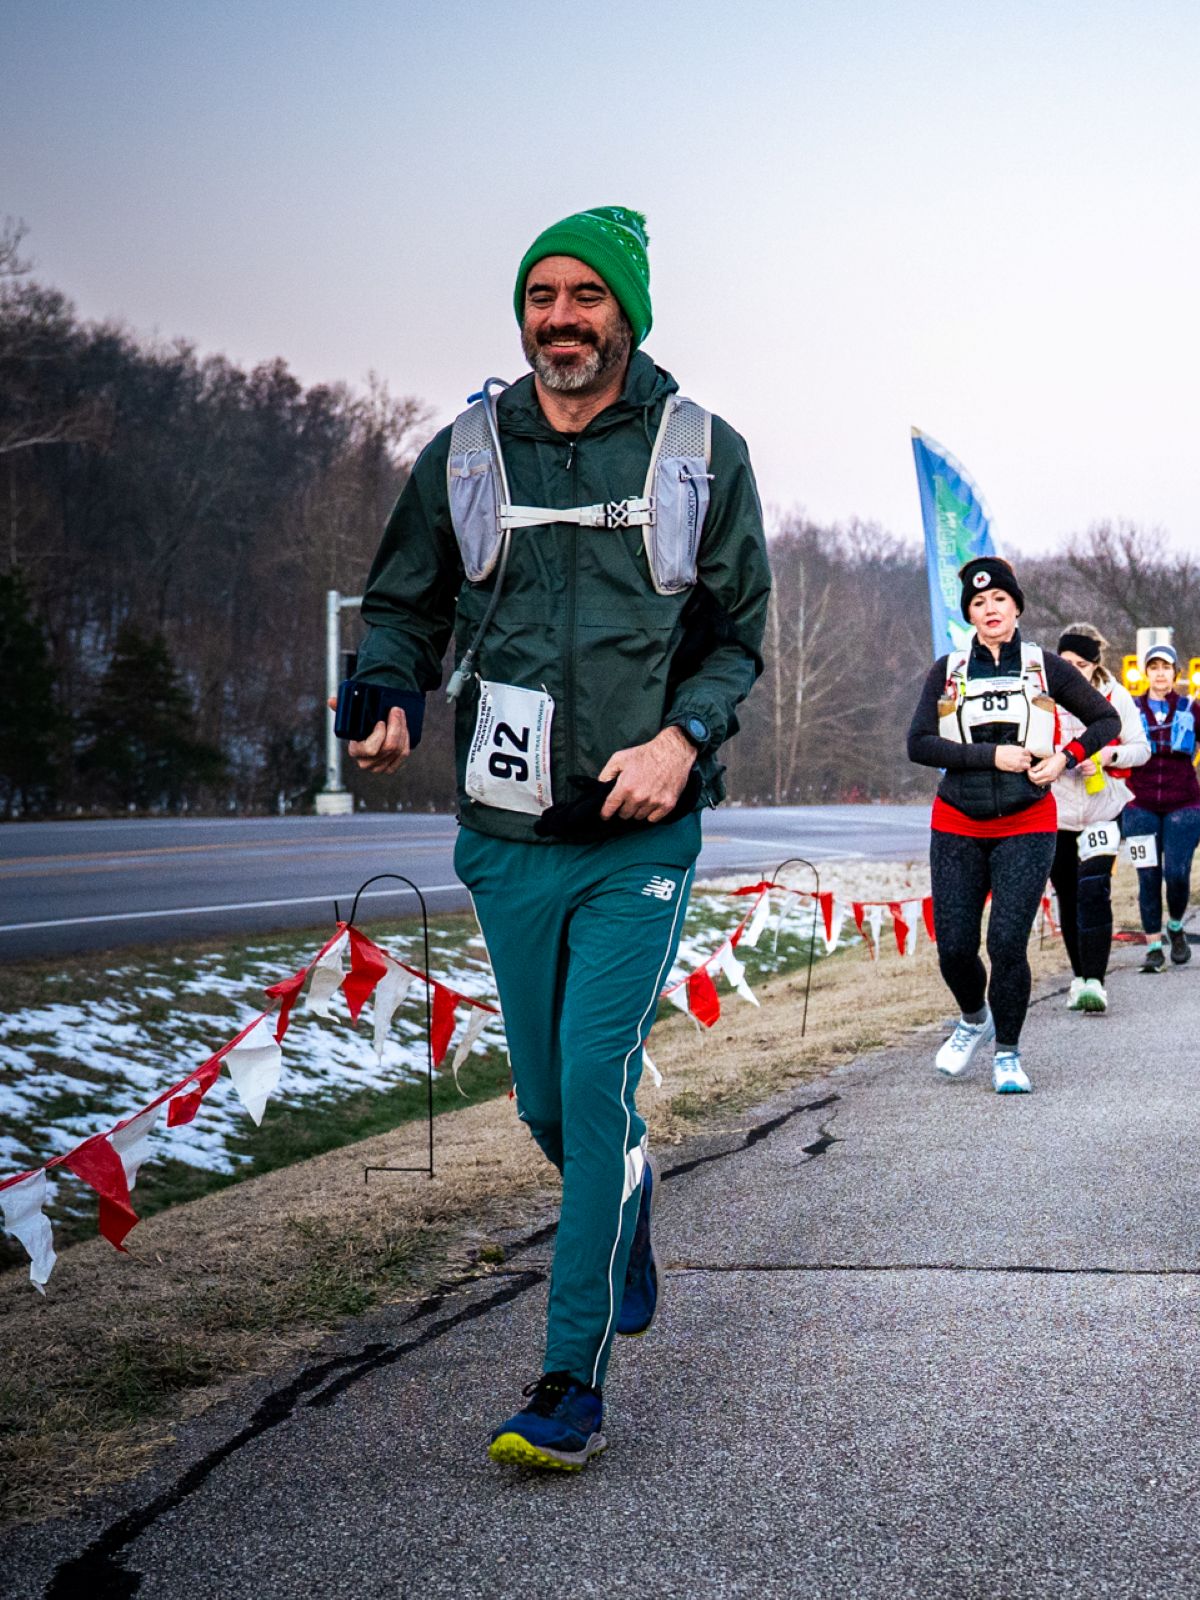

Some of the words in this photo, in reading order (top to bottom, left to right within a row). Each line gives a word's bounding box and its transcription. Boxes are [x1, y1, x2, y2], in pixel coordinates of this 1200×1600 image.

[477, 706, 492, 752] MARATHON
[536, 700, 545, 732] RUNNERS
[488, 721, 530, 782] 92
[1088, 830, 1108, 848] 89
[1130, 845, 1146, 860] 99
